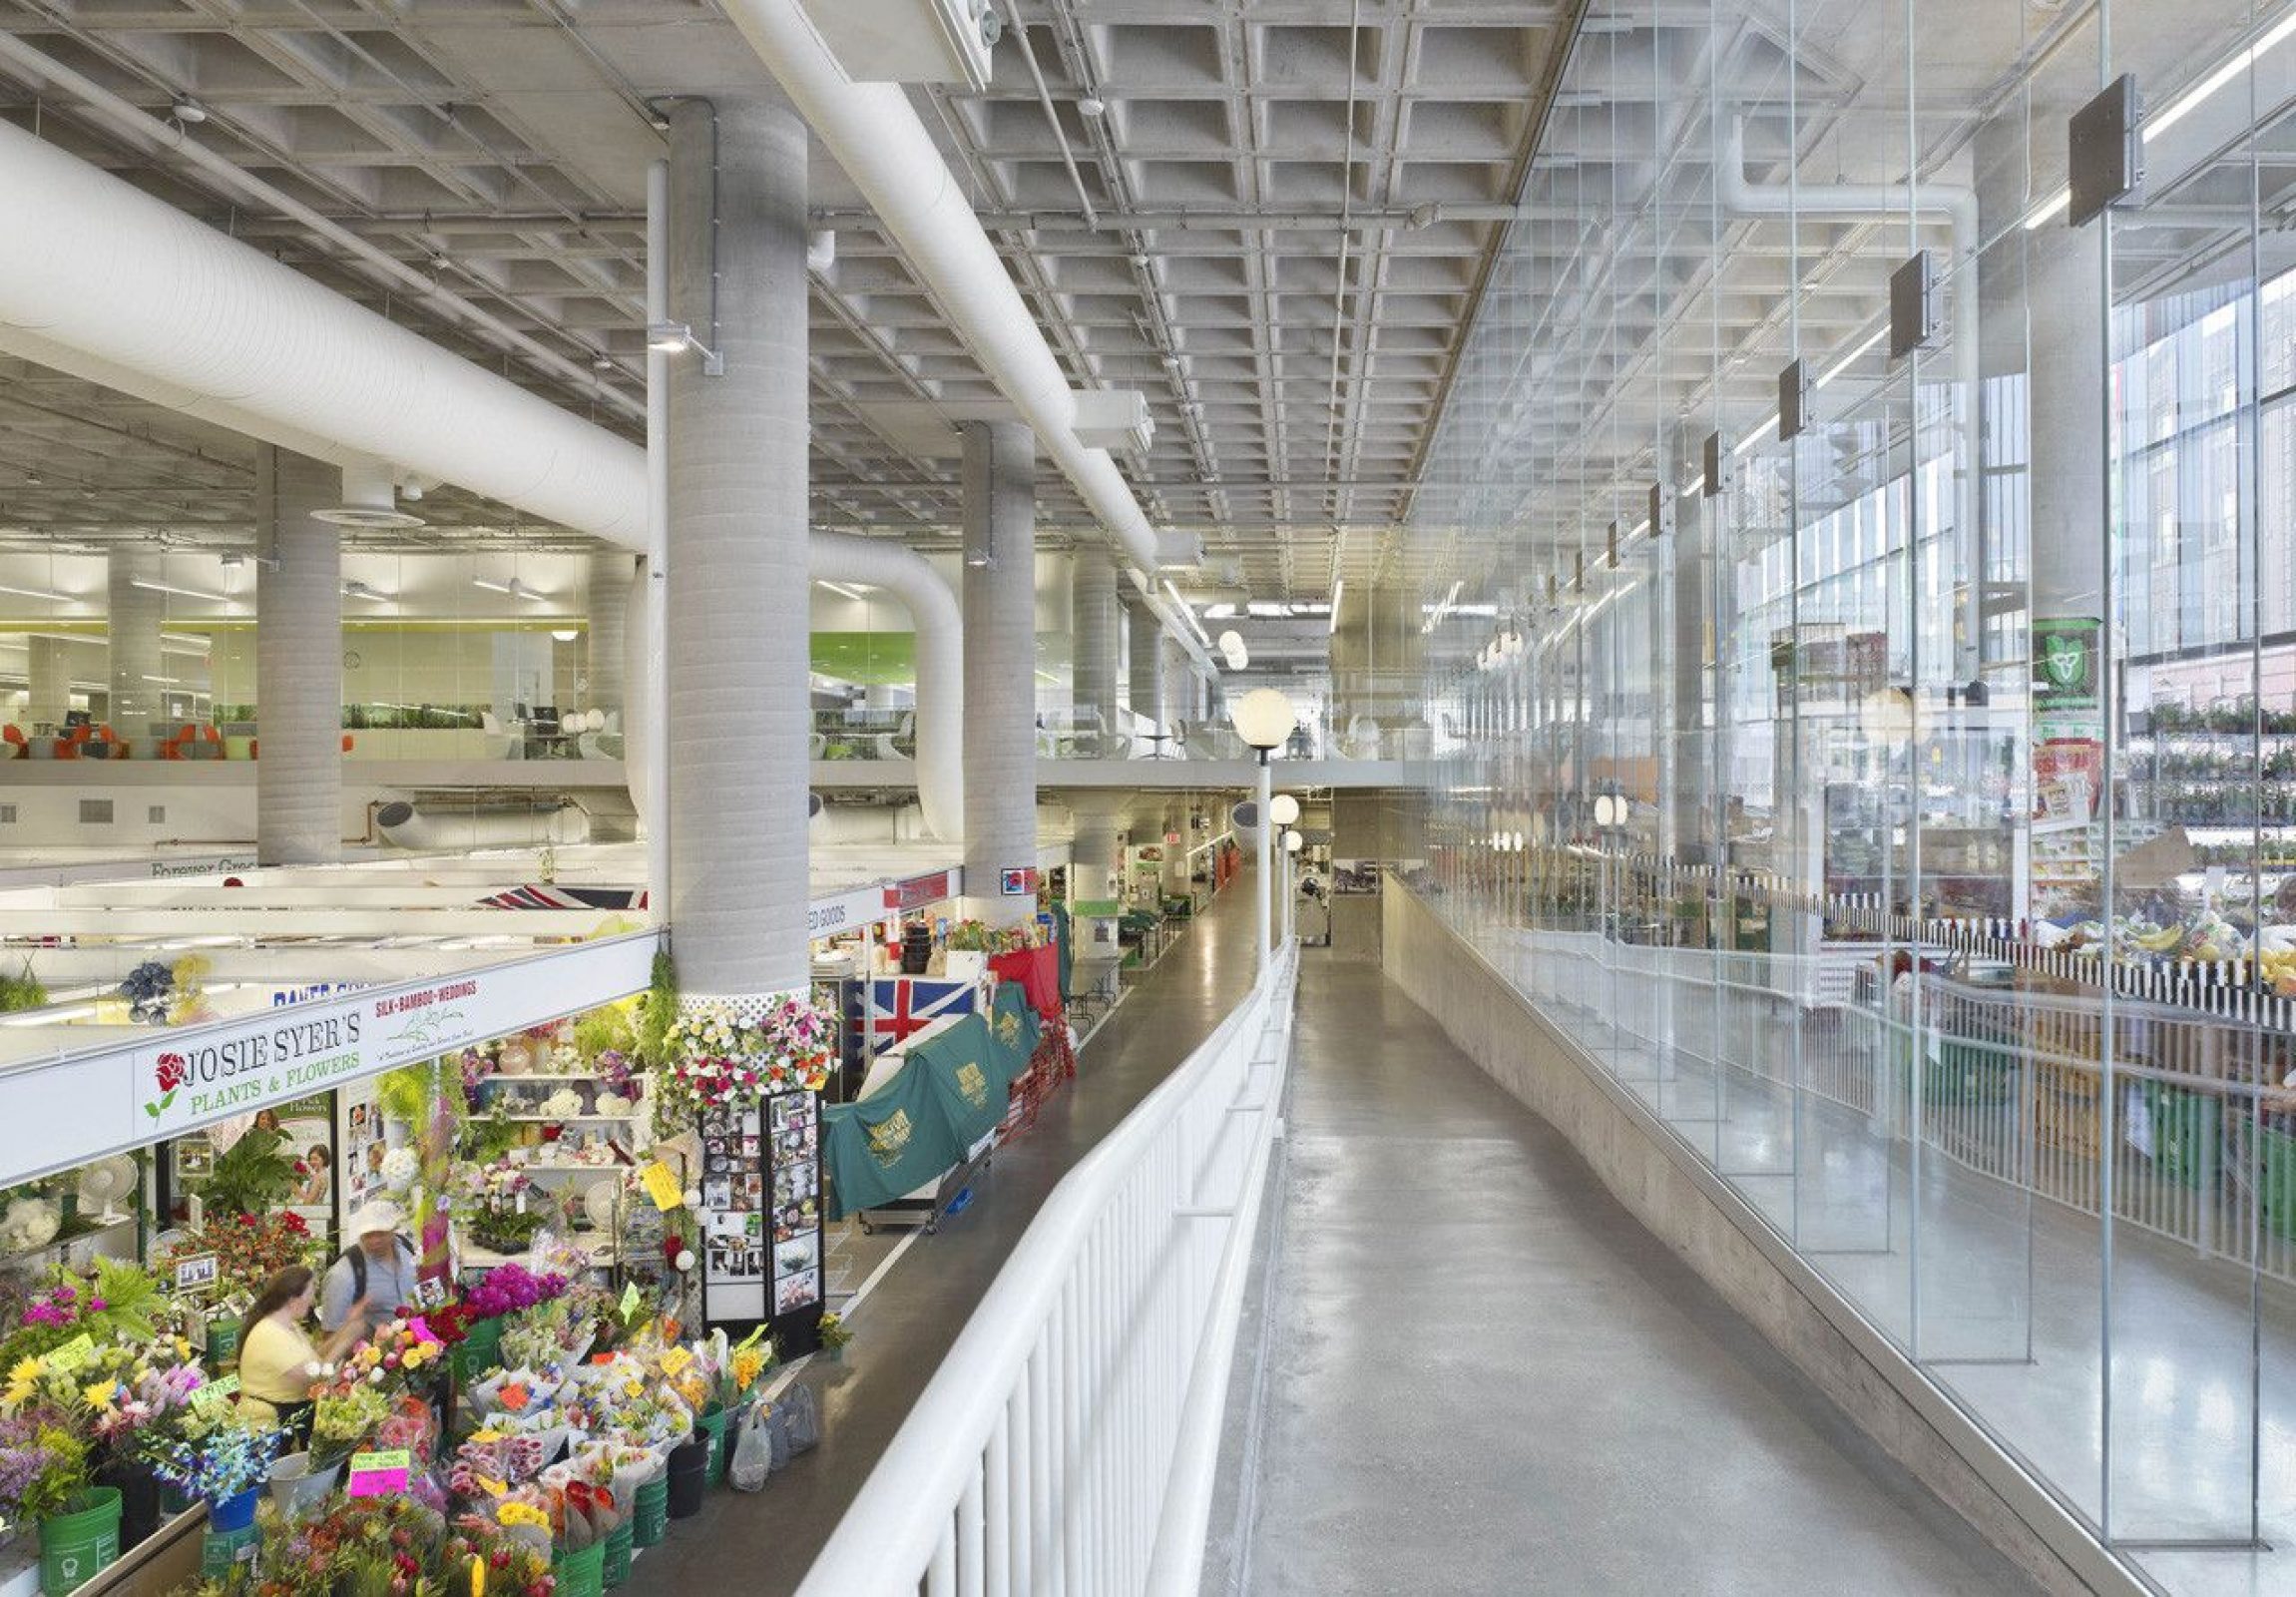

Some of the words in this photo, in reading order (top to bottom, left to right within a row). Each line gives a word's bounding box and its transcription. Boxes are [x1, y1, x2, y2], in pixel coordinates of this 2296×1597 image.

[183, 1034, 268, 1087] JOSIE
[273, 1010, 361, 1063] SYER'S
[191, 1079, 262, 1115] PLANTS
[268, 1076, 281, 1093] &
[286, 1051, 360, 1088] FLOWERS
